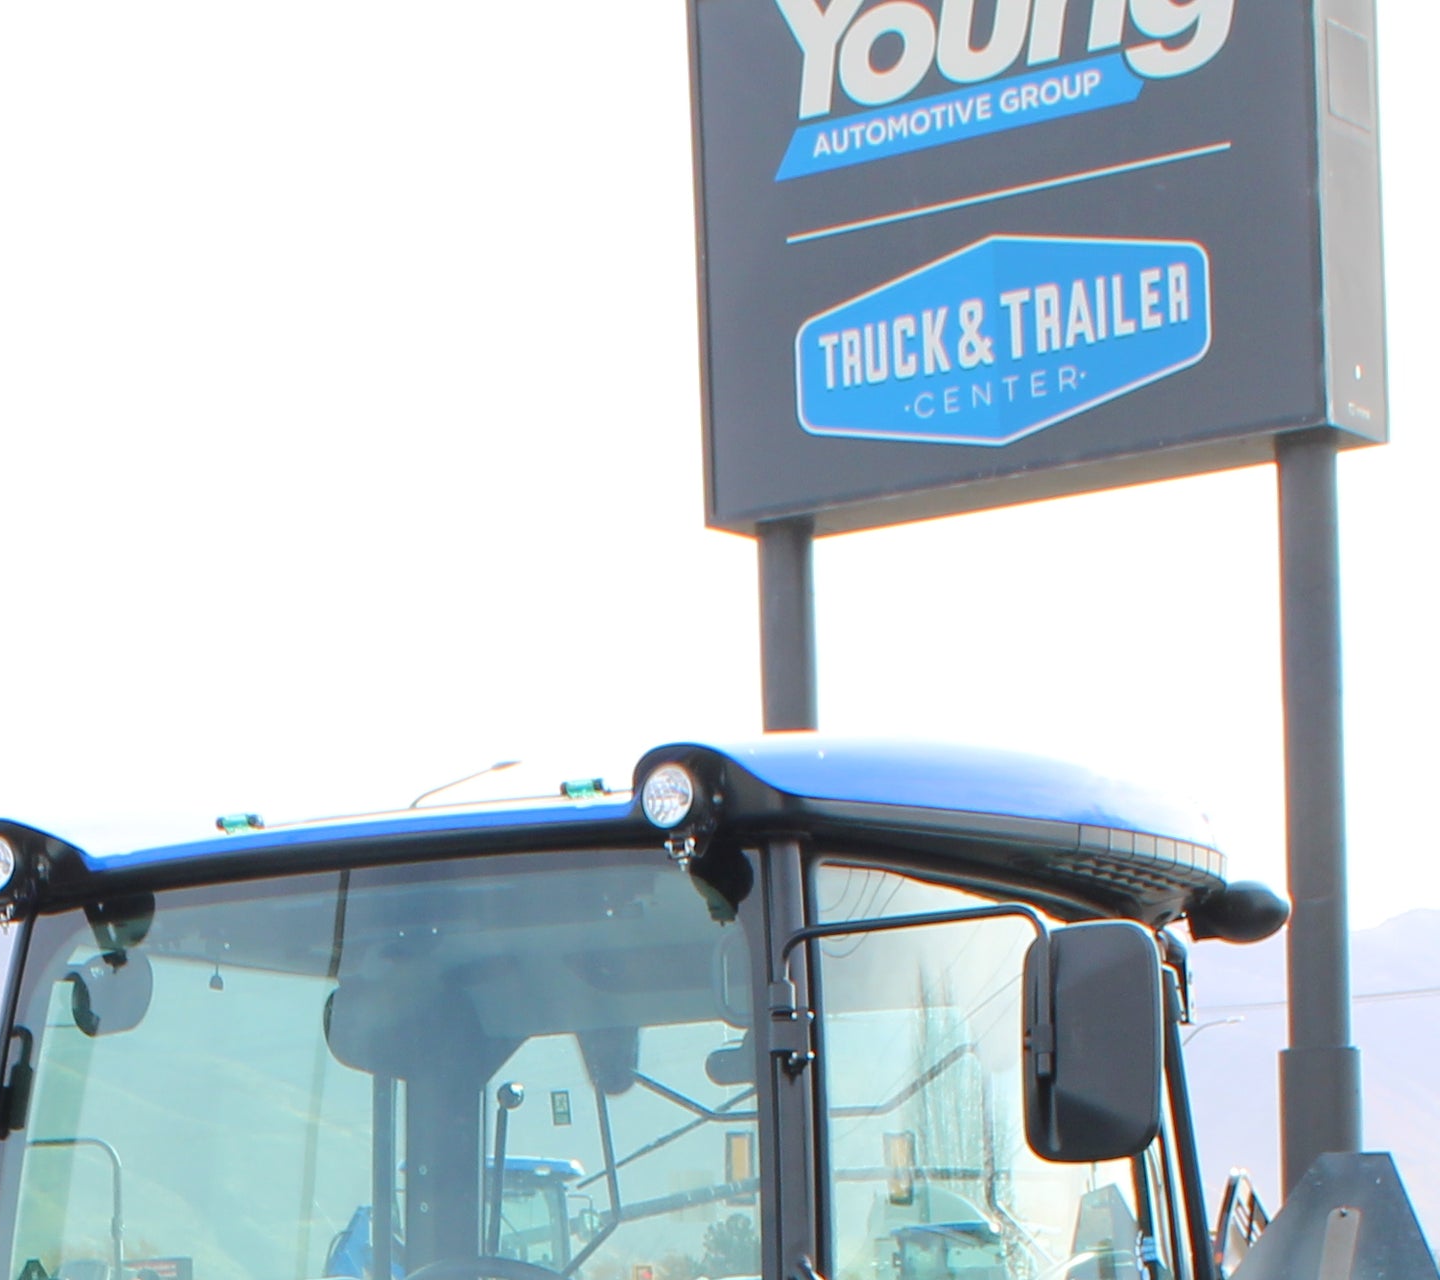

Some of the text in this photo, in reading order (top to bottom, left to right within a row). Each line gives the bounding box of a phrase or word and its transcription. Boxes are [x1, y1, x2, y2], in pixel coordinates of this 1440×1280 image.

[775, 0, 1233, 120] Young
[812, 71, 1103, 159] AUTOMOTIVE GROUP
[817, 263, 1190, 391] TRUCK & TRAILER
[913, 365, 1079, 420] CENTER
